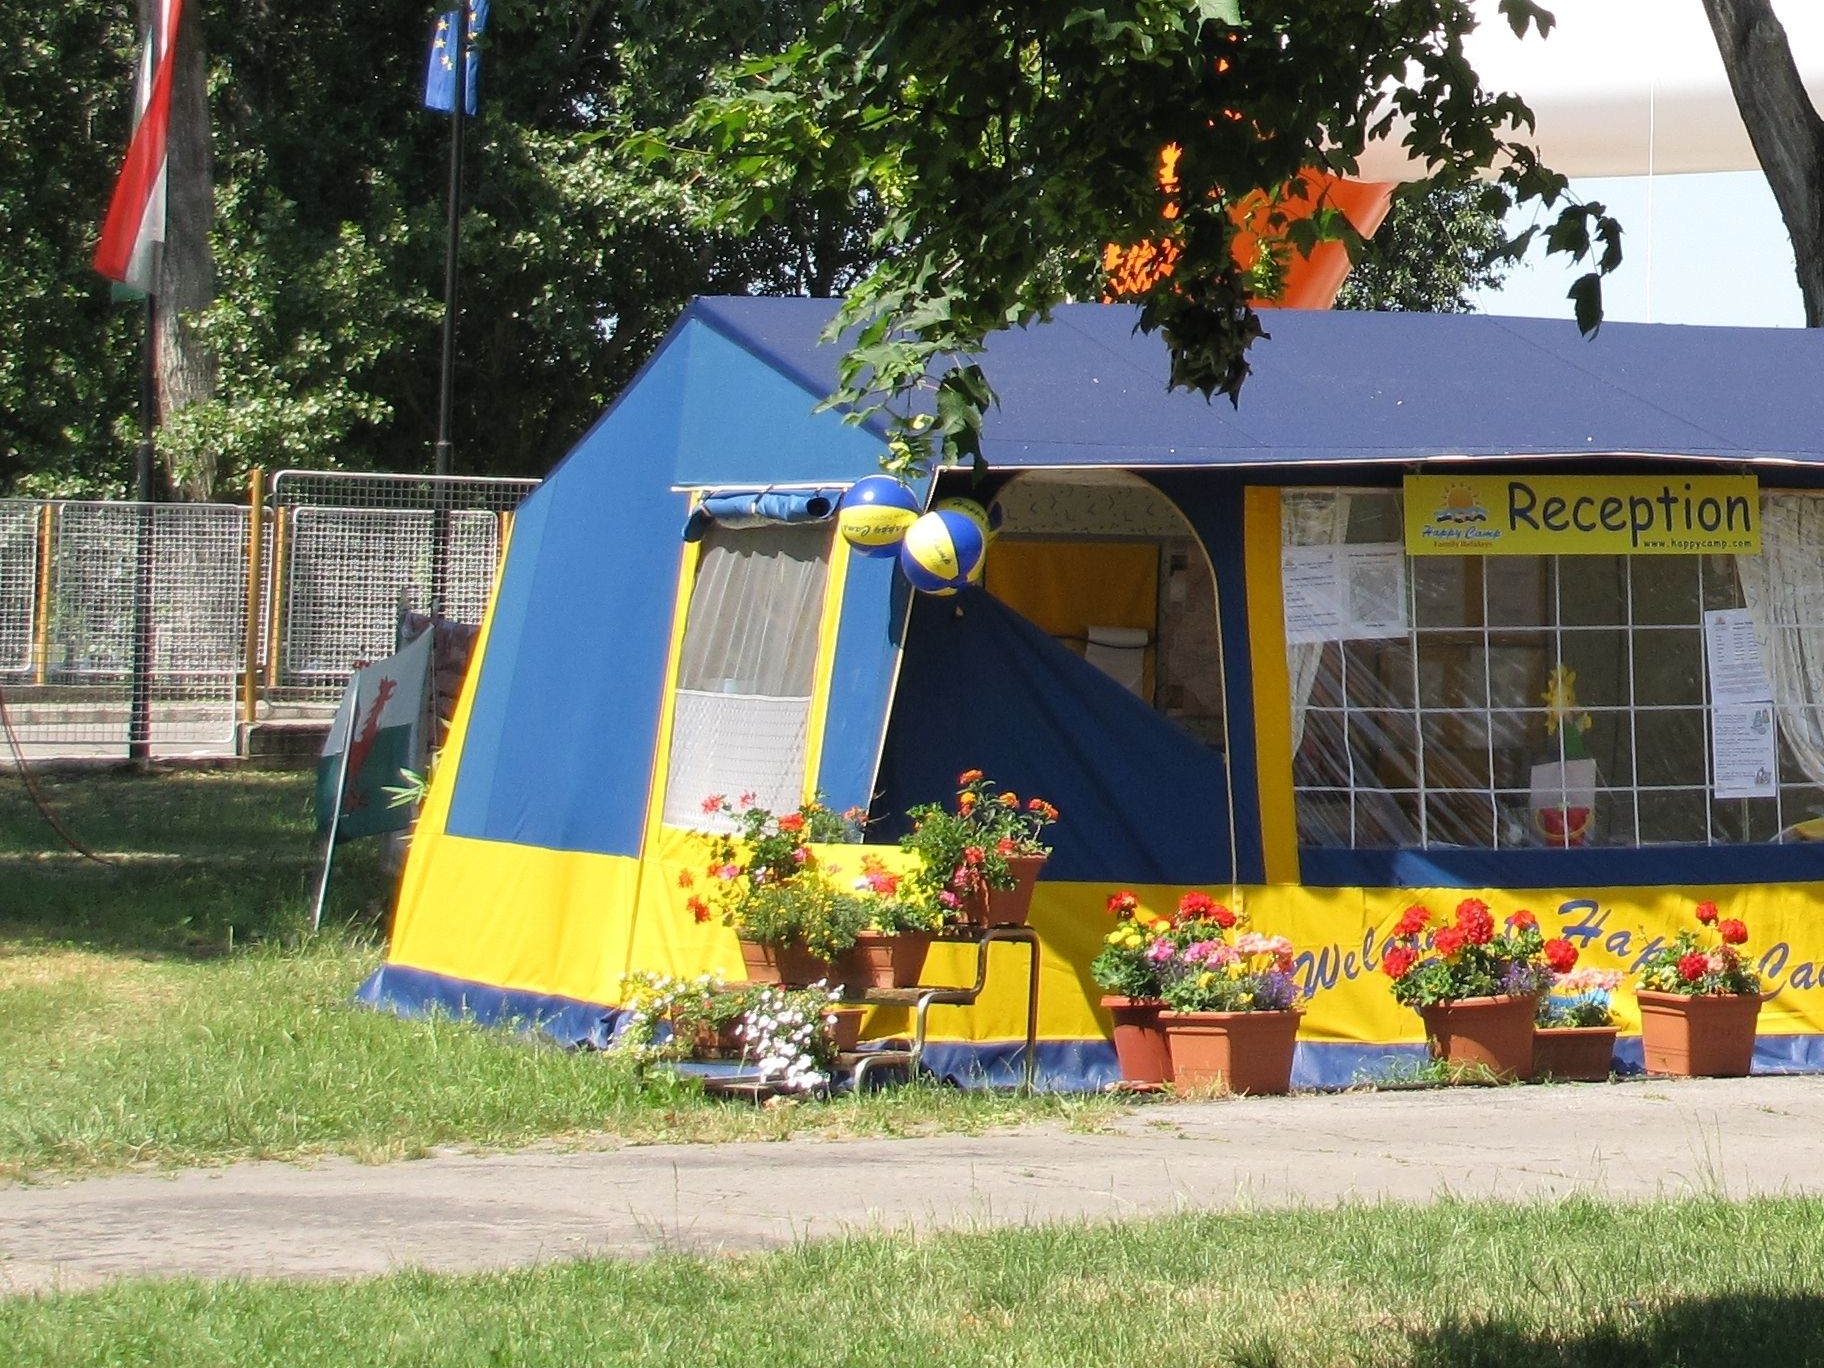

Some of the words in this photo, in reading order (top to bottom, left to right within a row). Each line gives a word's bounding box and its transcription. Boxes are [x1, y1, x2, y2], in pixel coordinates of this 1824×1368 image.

[1508, 482, 1751, 548] Reception
[1422, 525, 1461, 540] Happy
[1465, 525, 1502, 540] Camp
[1643, 537, 1752, 550] www.happycamp.com
